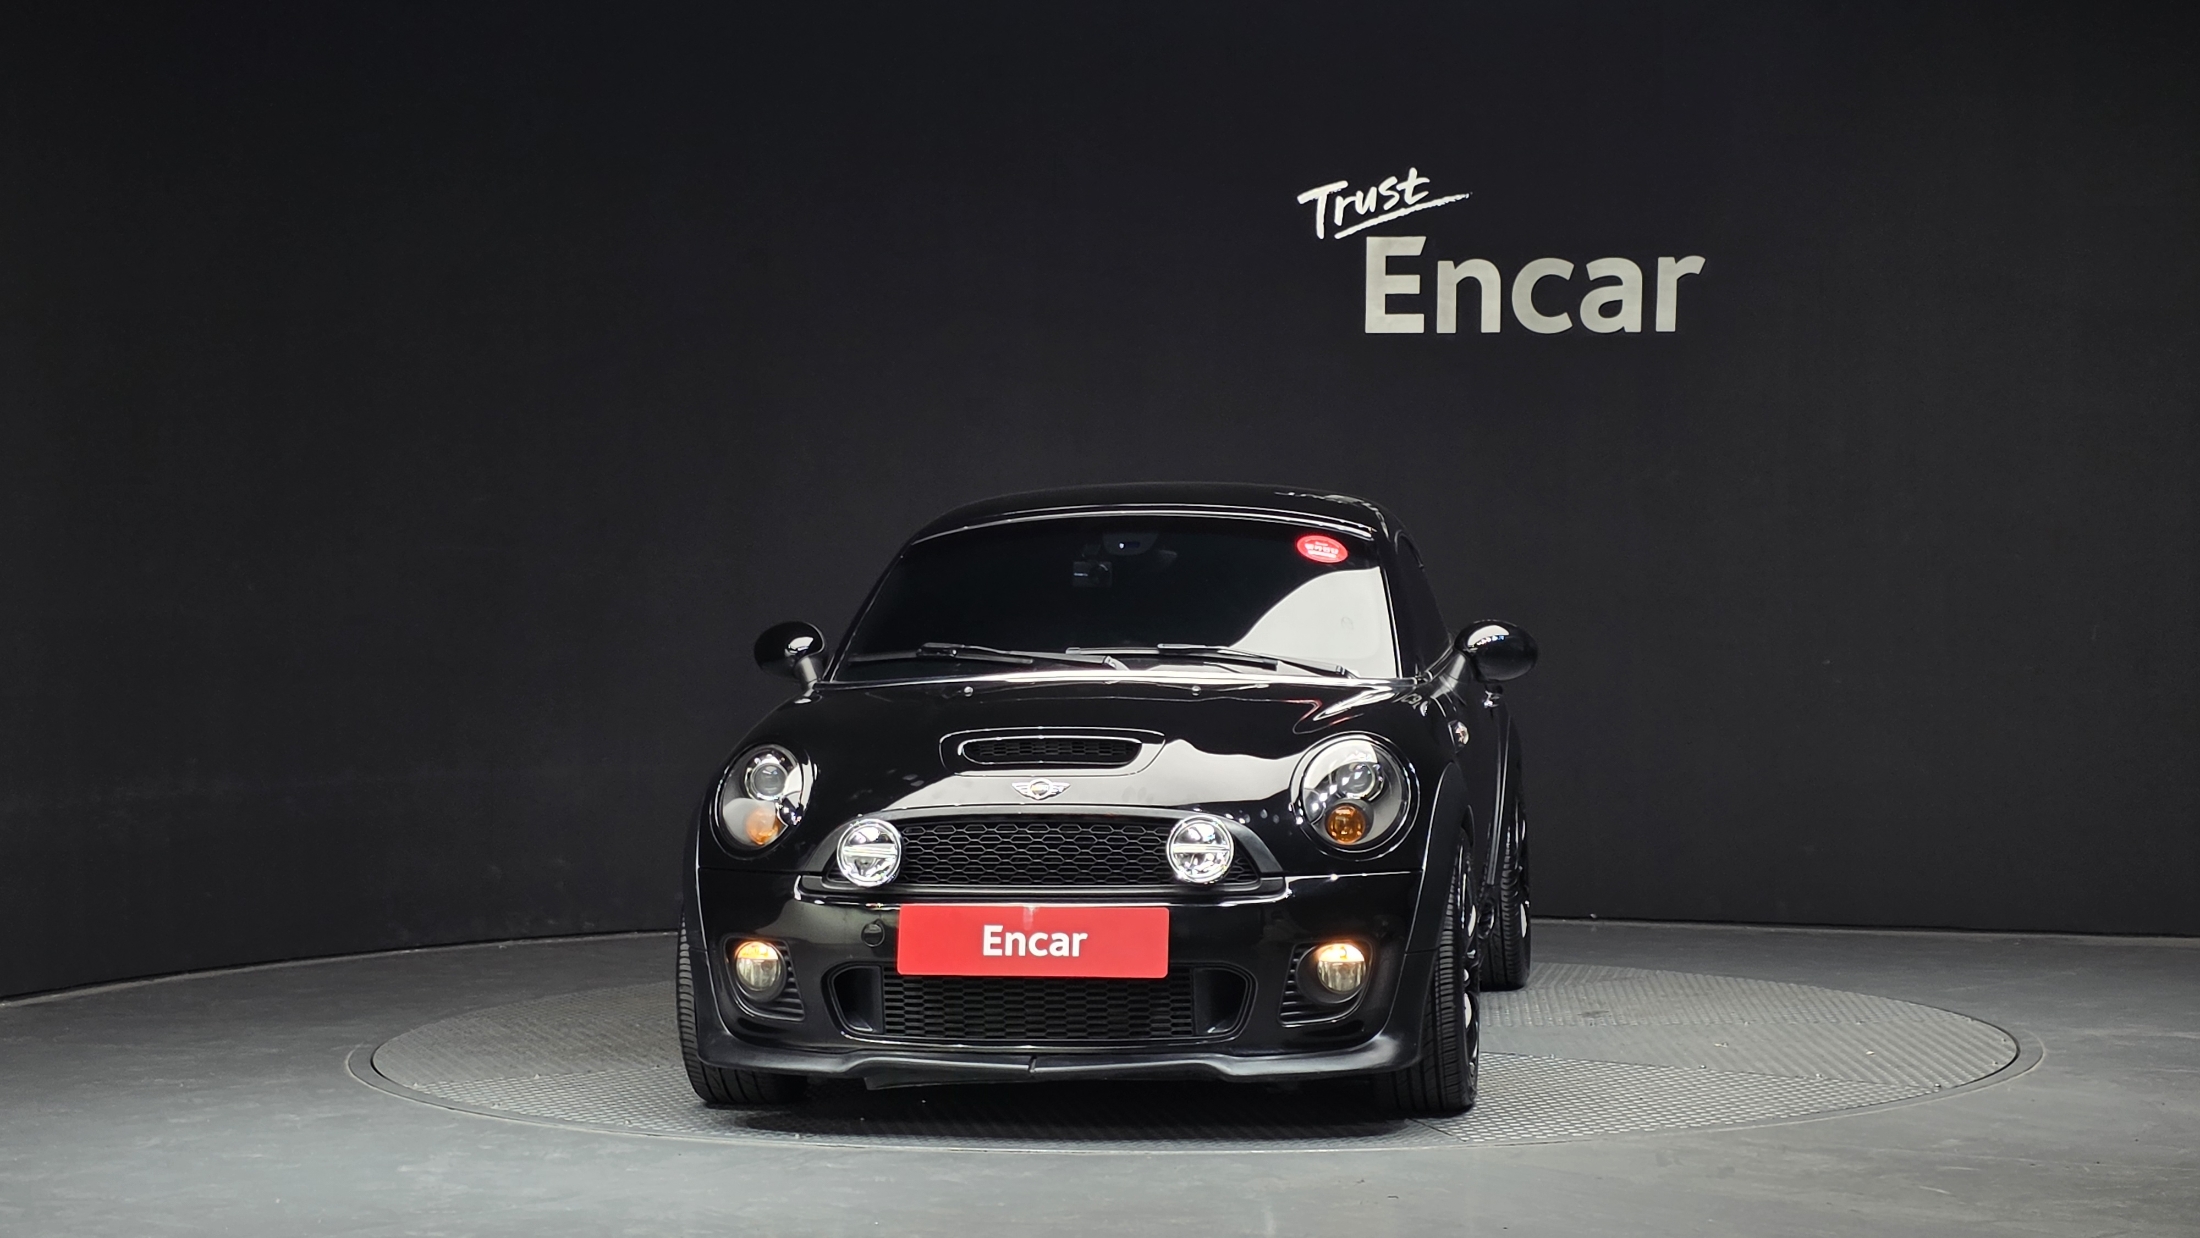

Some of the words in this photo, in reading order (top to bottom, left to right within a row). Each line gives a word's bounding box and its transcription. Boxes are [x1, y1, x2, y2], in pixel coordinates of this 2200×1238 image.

[1296, 167, 1431, 240] Trust
[1364, 235, 1706, 334] Encar
[982, 924, 1089, 957] Encar
